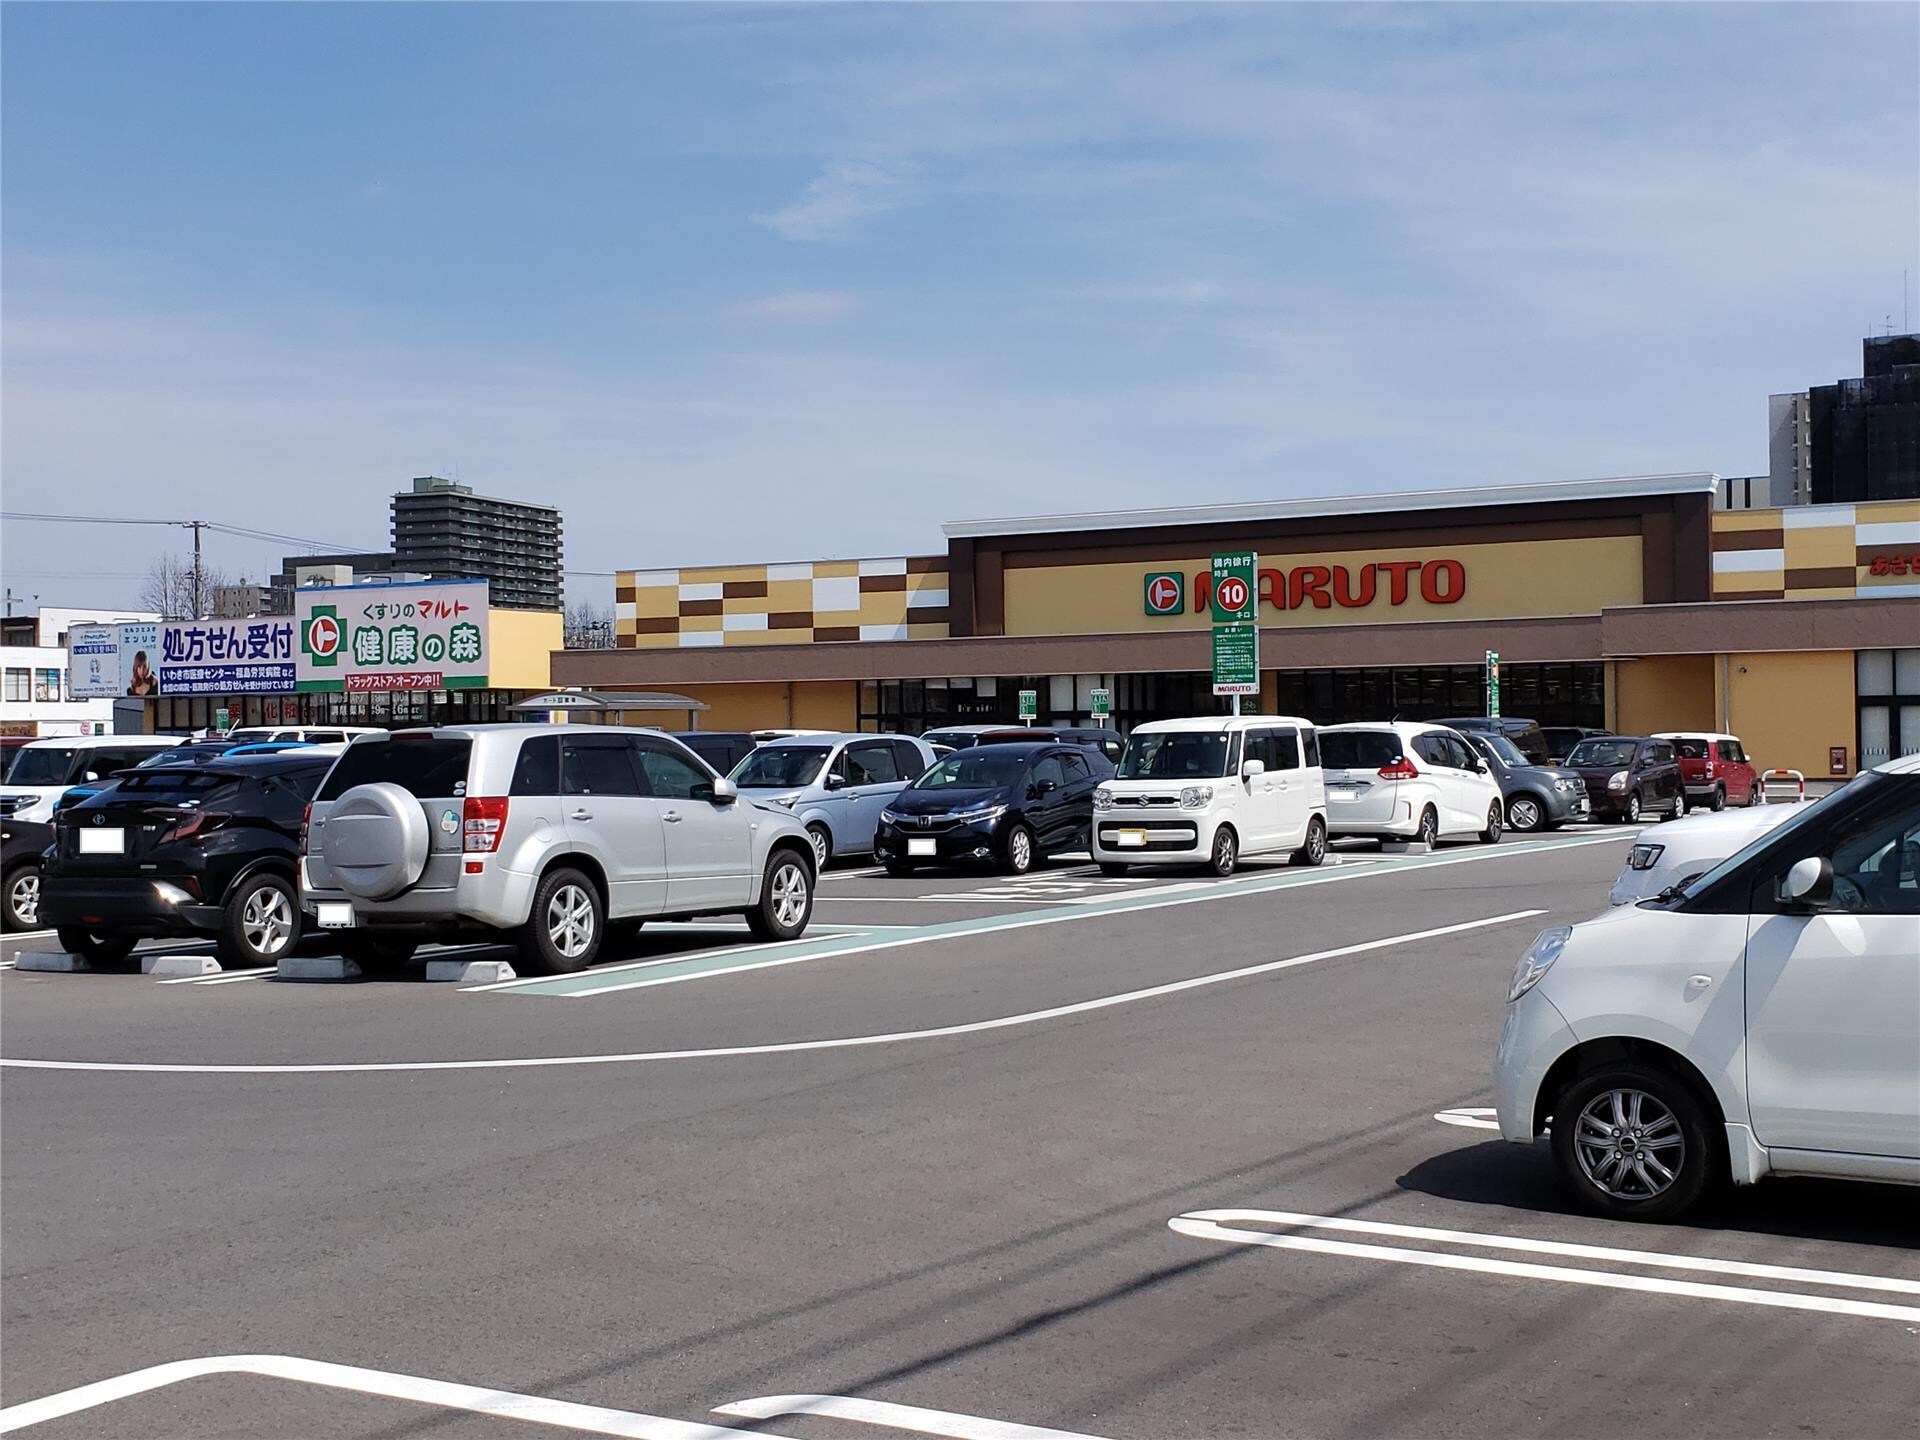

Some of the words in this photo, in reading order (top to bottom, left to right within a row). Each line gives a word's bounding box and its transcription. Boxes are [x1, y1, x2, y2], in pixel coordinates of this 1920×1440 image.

[1213, 556, 1251, 568] 構内徐行
[1222, 584, 1244, 604] 10
[362, 600, 470, 620] くすりのマルト
[162, 623, 294, 663] 処方せん受付
[355, 622, 481, 667] 健康の森
